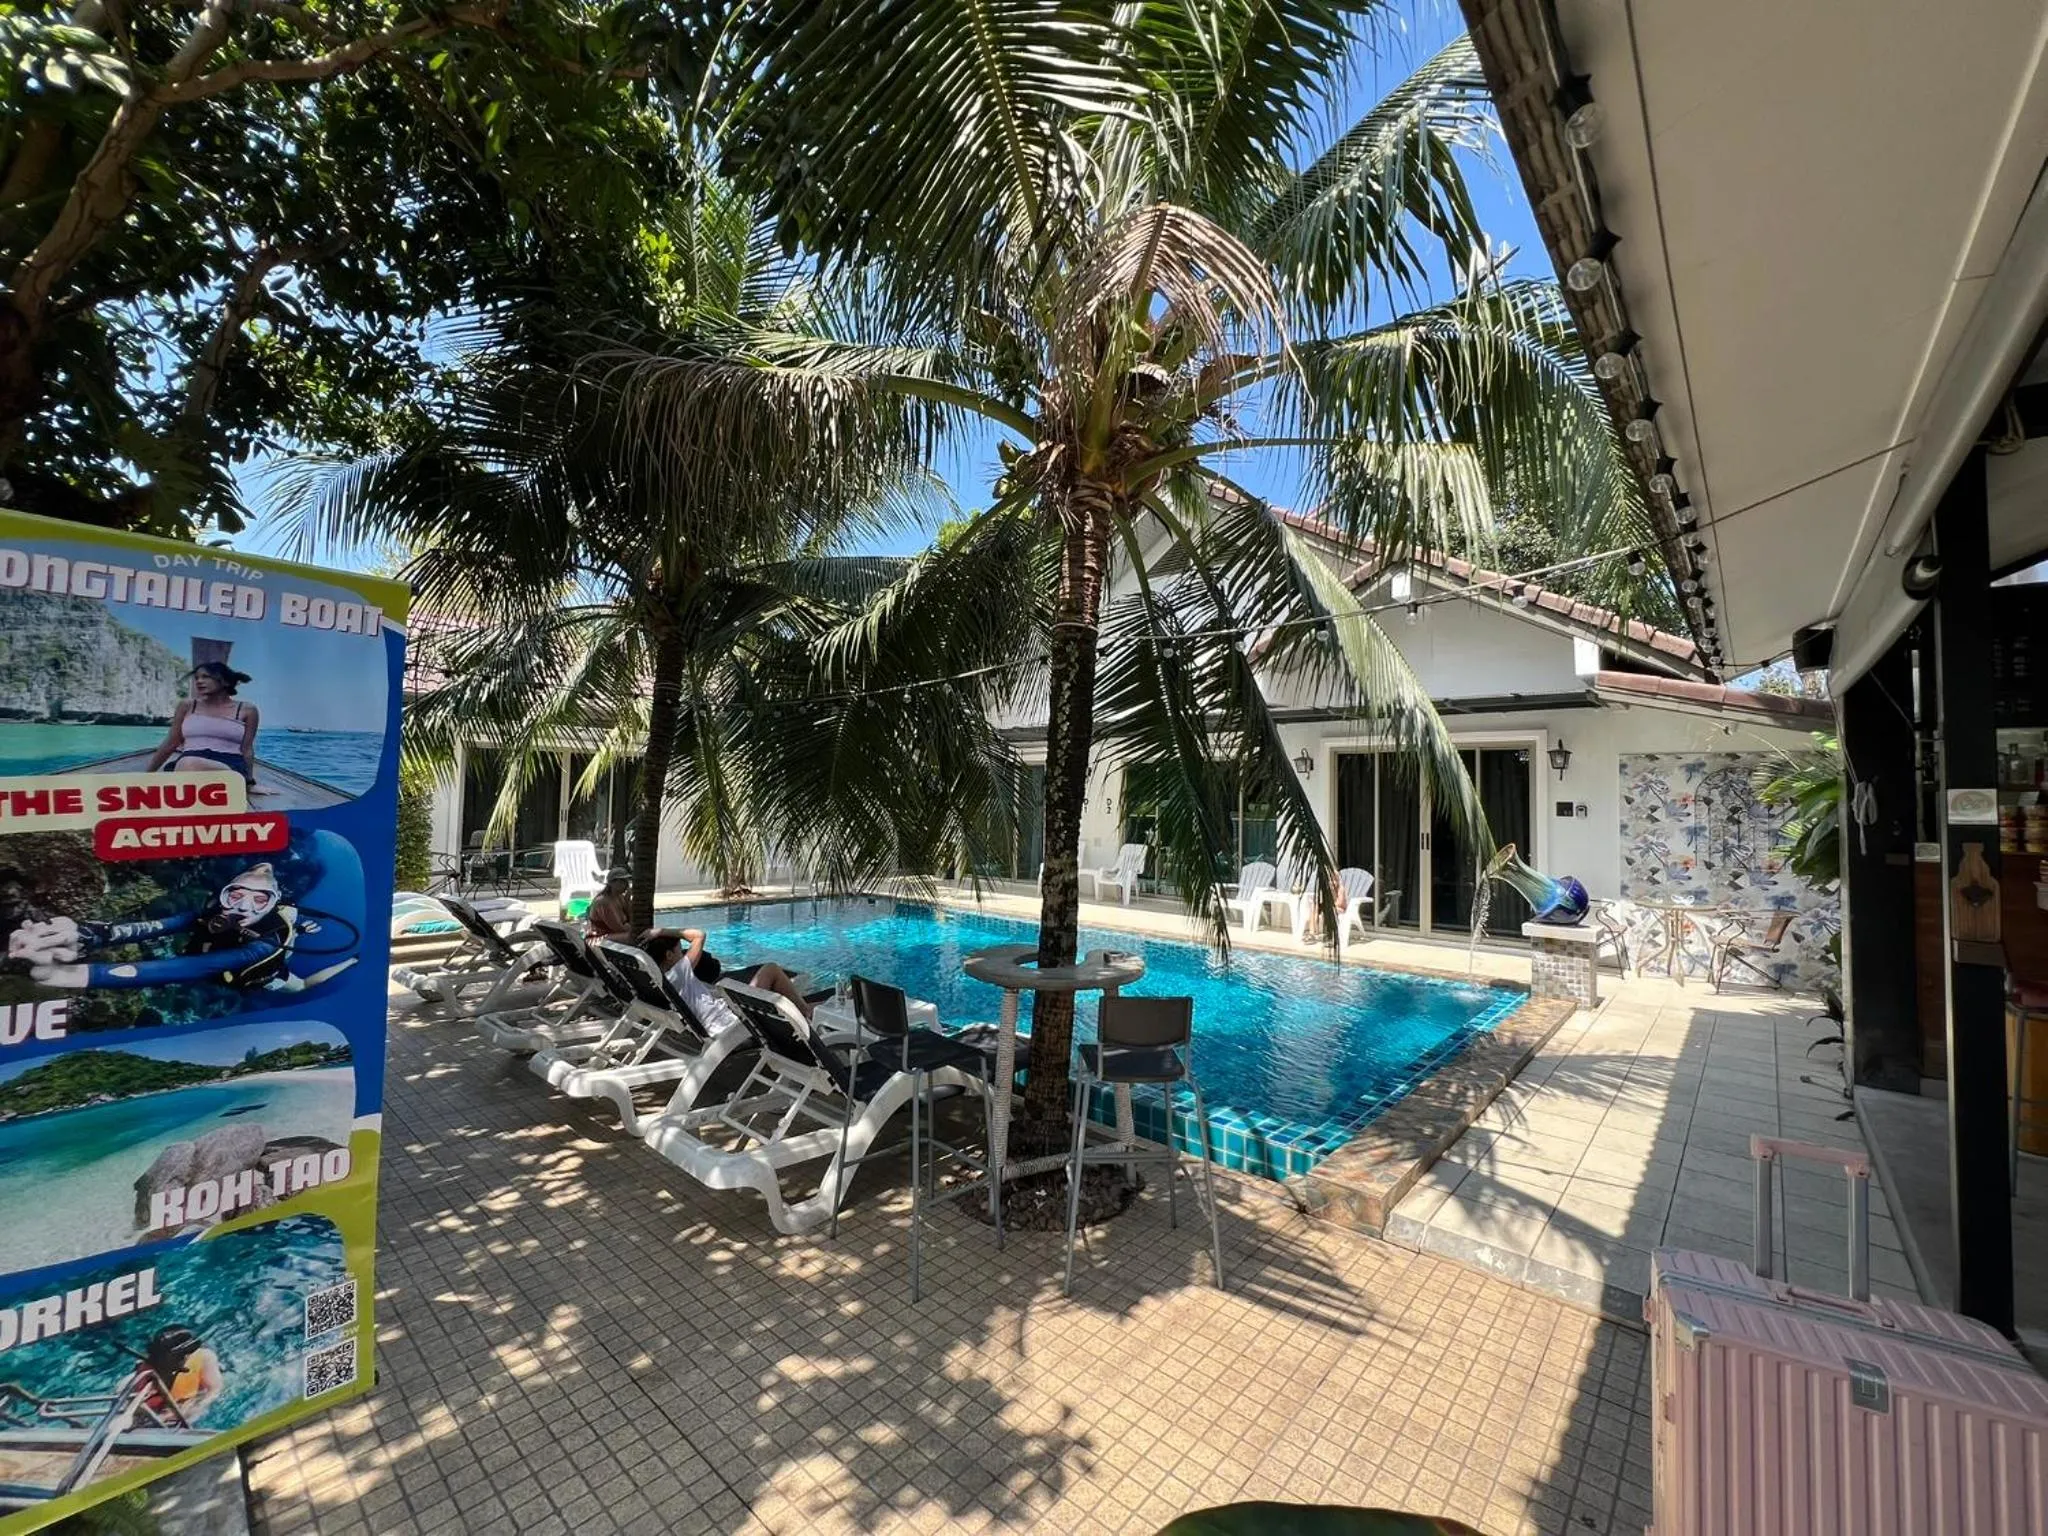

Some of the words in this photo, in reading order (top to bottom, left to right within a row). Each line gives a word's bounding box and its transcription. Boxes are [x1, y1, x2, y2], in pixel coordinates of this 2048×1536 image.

[153, 554, 203, 569] DAY
[212, 556, 264, 580] TRIP
[0, 548, 266, 621] ONGTAILED
[281, 592, 383, 637] BOAT
[0, 788, 83, 817] HE
[96, 783, 228, 812] SNUG
[111, 822, 276, 849] ACTIVITY
[150, 1169, 256, 1230] KOH
[268, 1149, 351, 1198] TAO
